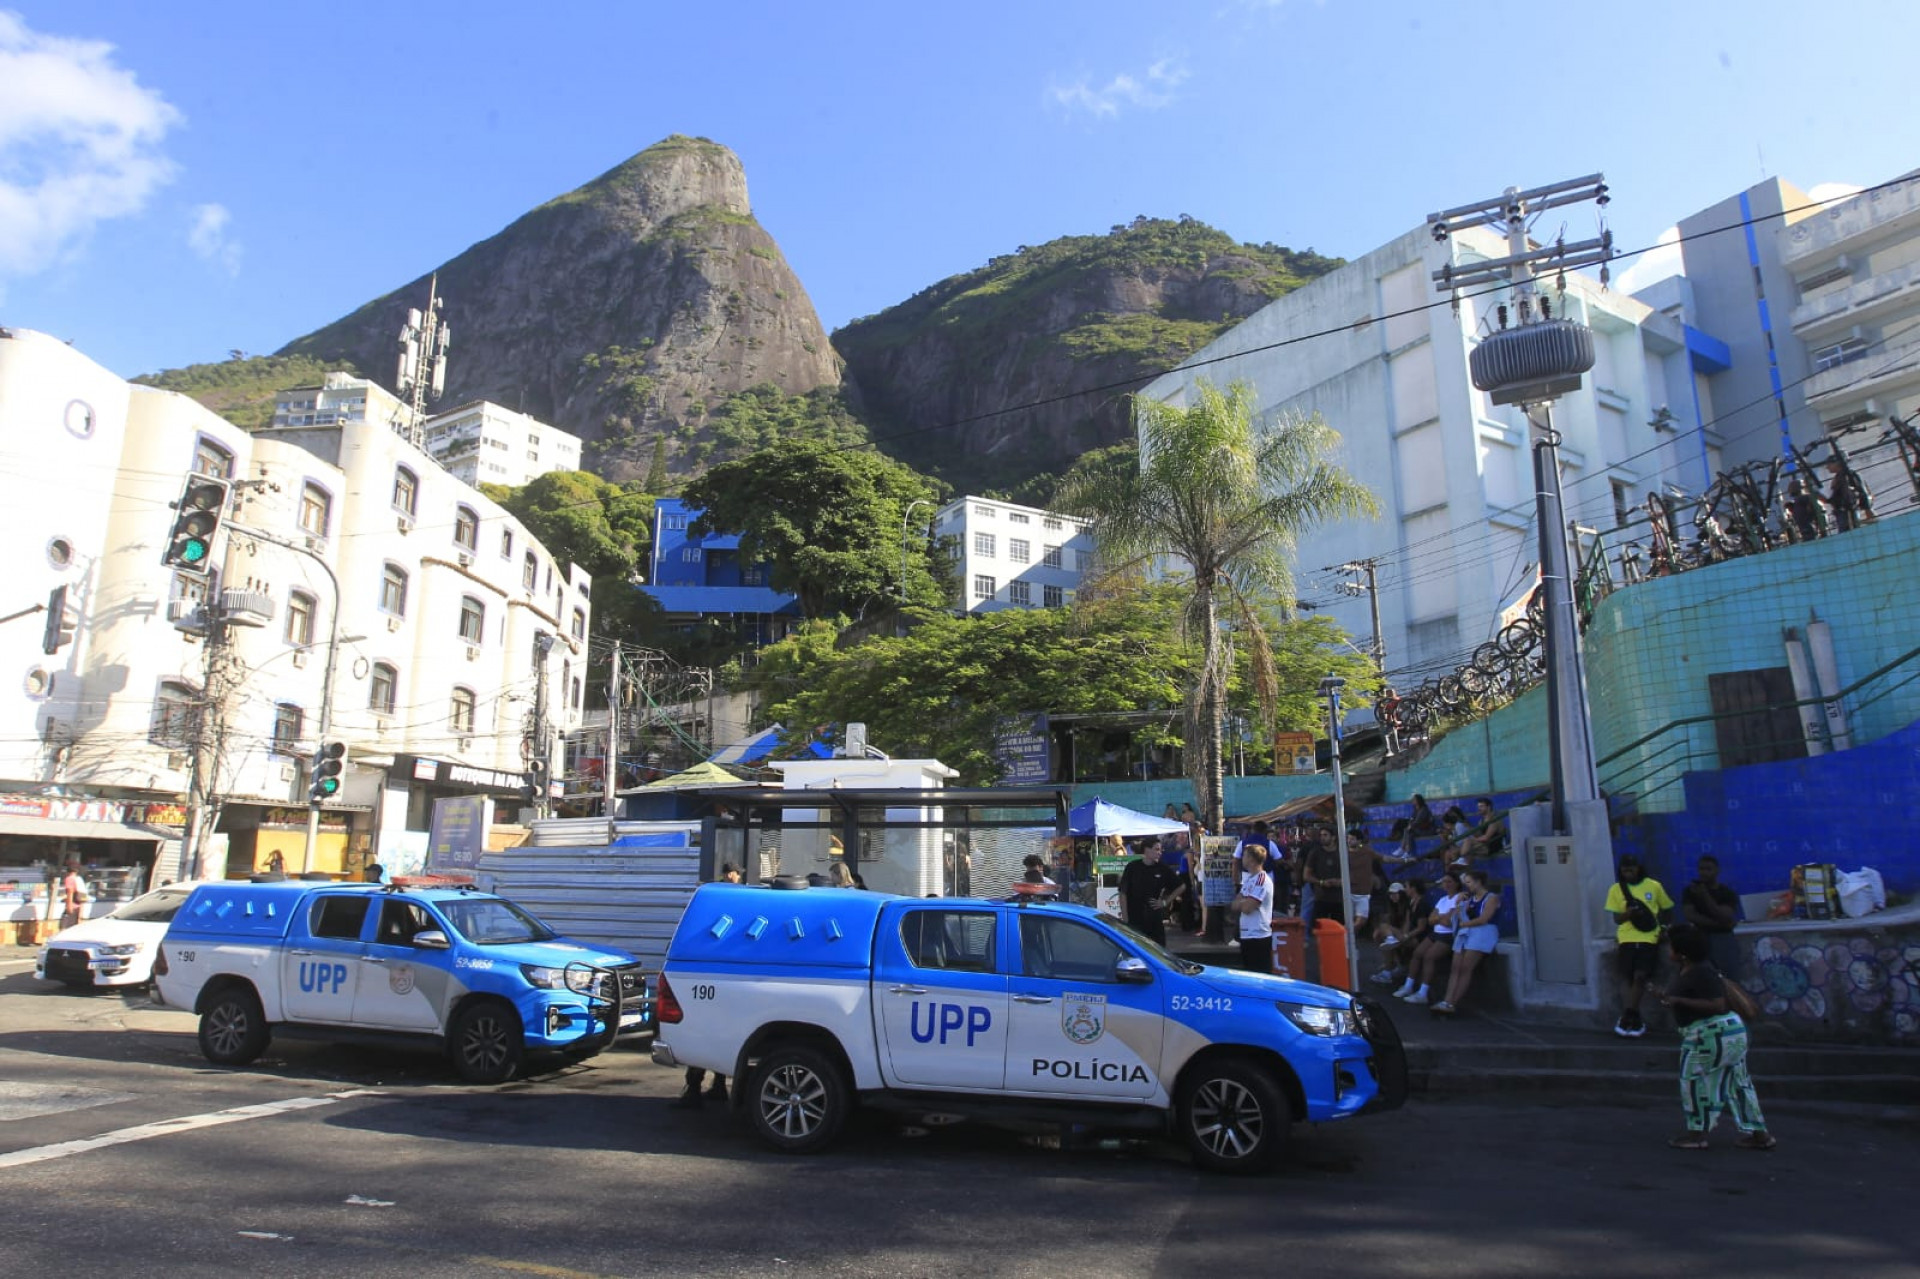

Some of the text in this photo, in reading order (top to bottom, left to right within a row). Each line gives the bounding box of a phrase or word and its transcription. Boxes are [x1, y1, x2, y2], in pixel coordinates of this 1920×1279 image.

[301, 962, 347, 994] UPP
[691, 984, 715, 1000] 190
[1171, 995, 1232, 1011] 52-3412
[911, 1001, 991, 1047] UPP
[1032, 1058, 1150, 1083] POLÍCIA
